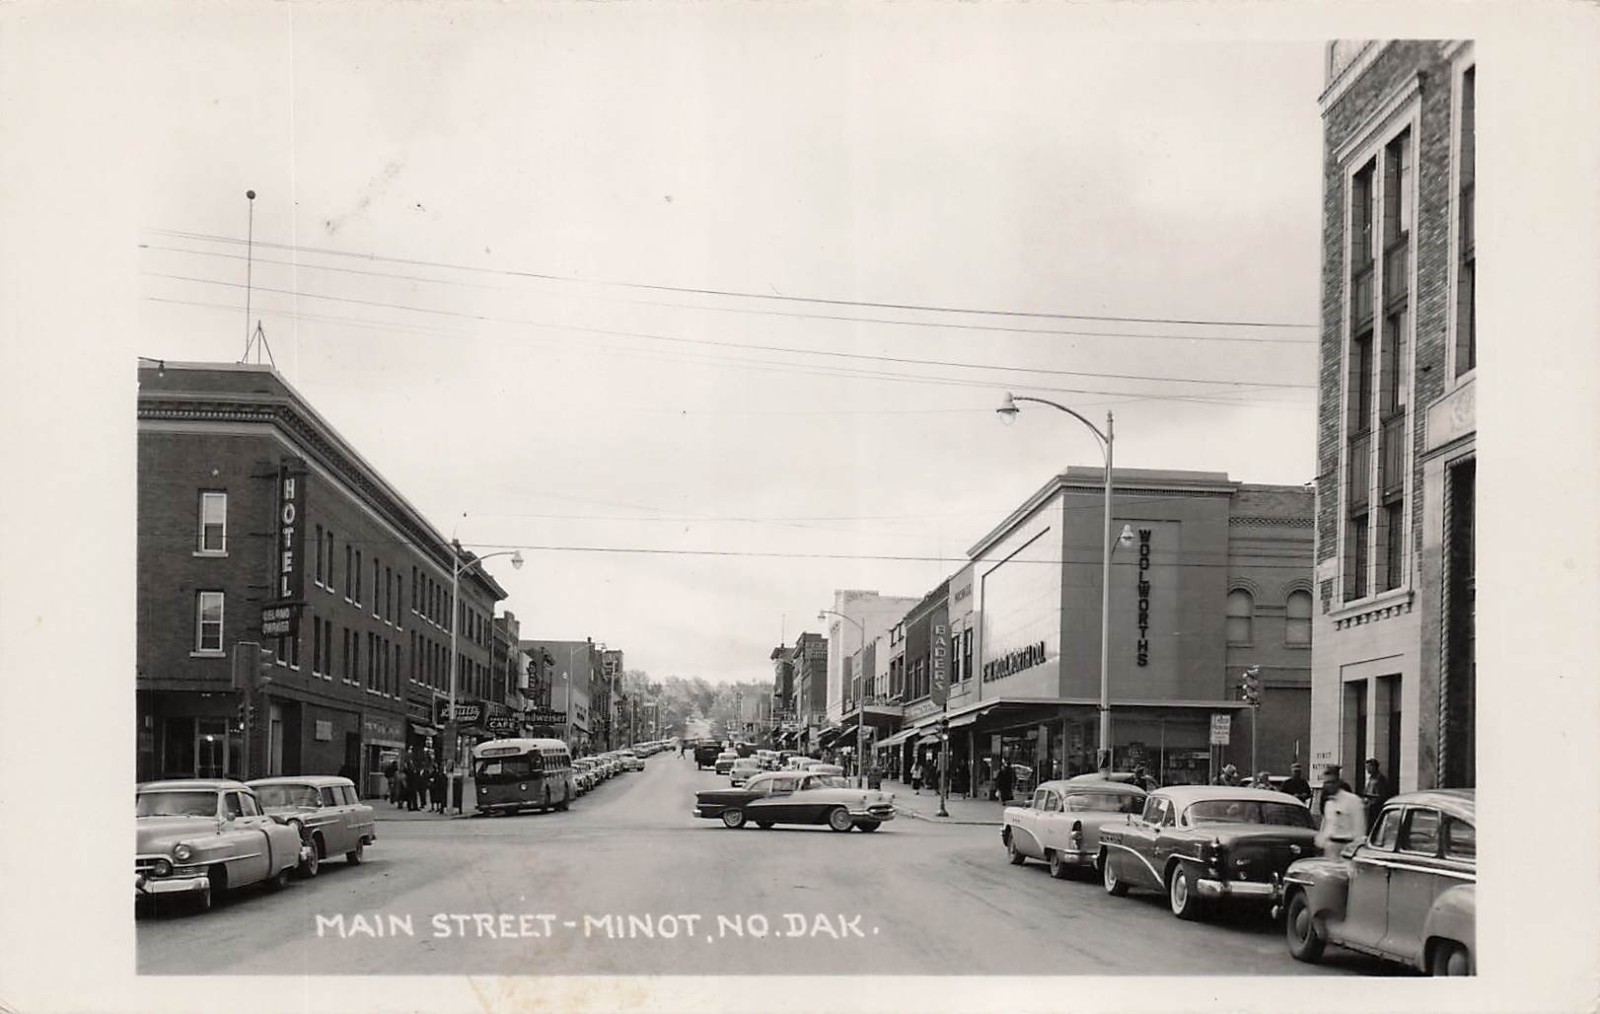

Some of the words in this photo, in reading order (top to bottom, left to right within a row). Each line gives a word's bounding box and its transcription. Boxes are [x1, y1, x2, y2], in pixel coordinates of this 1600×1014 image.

[282, 478, 296, 597] HOTEL
[1138, 529, 1151, 667] WOOLWORTHS
[489, 720, 516, 729] CAFE
